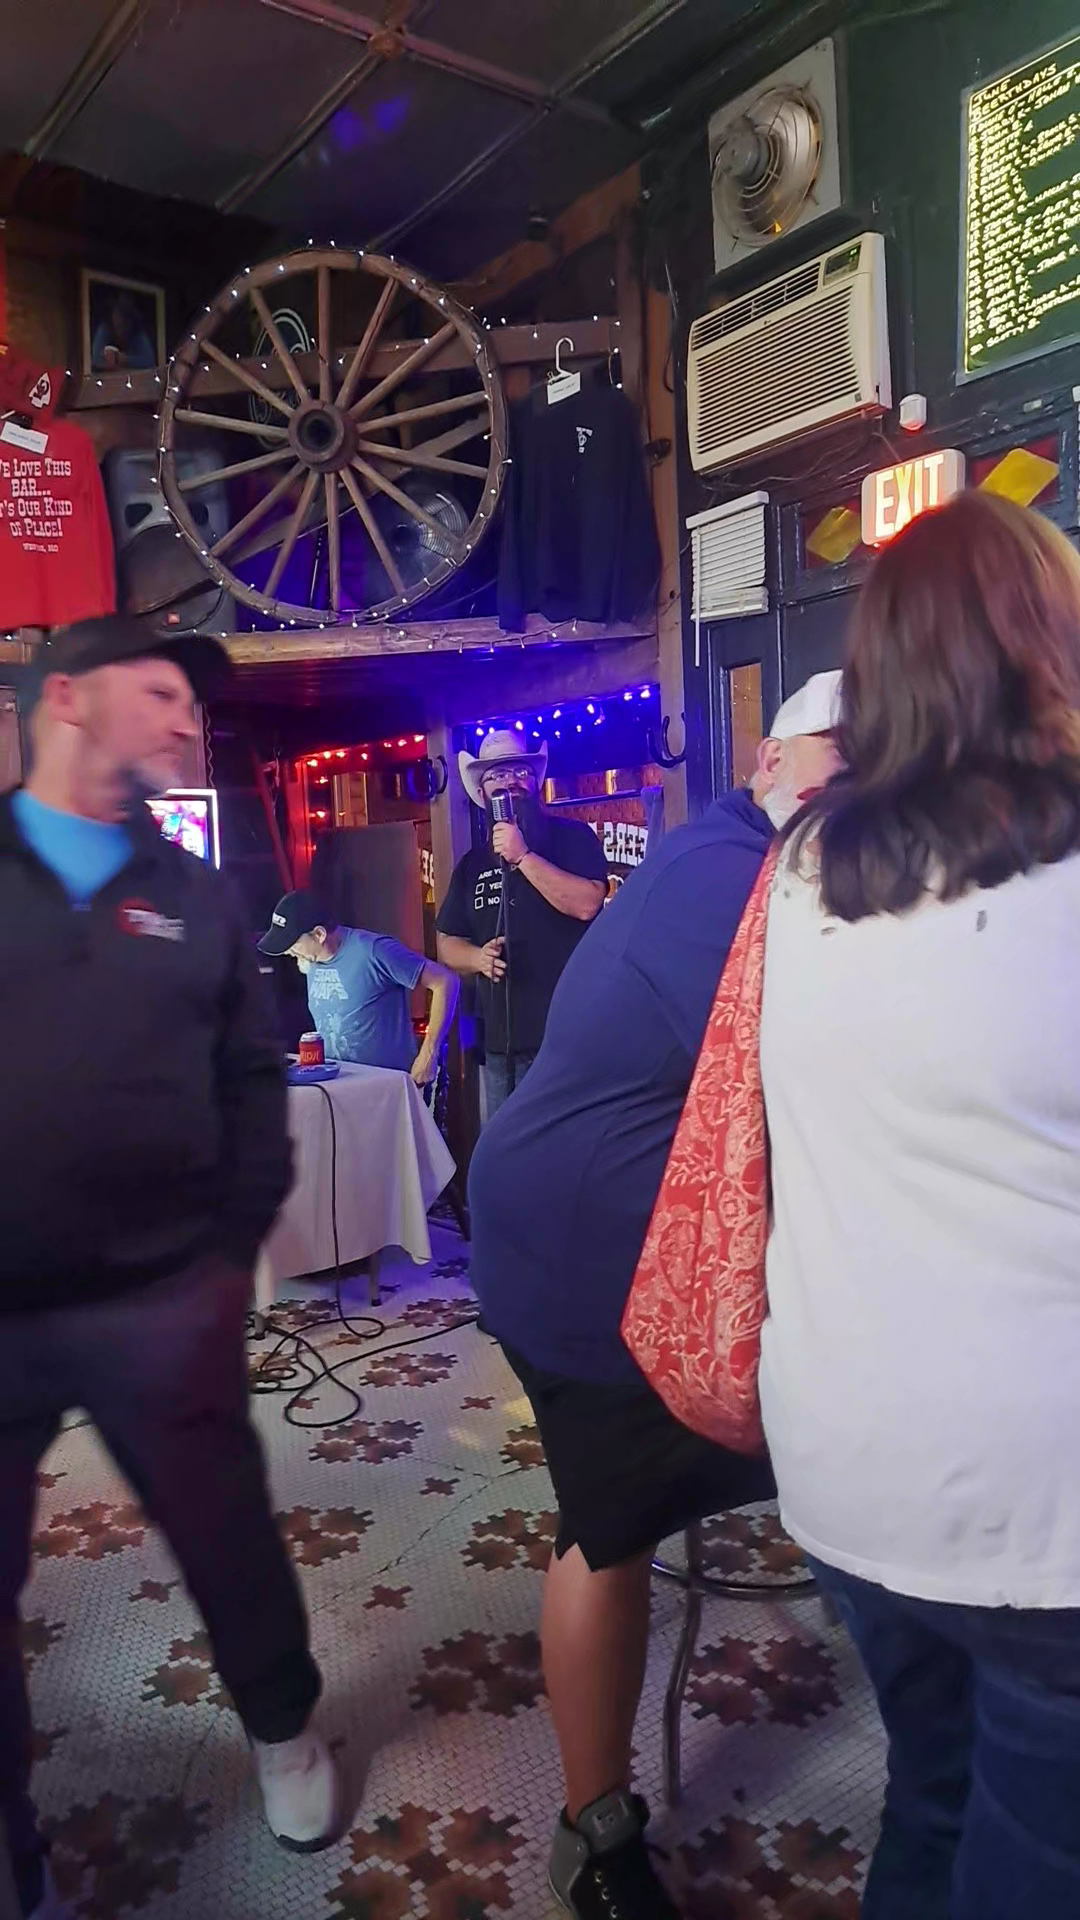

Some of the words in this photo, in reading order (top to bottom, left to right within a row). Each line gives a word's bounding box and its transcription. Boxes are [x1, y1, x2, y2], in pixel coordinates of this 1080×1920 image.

[971, 63, 1057, 122] BEERTHDAYS
[973, 79, 1011, 108] JUNE
[0, 459, 10, 477] E
[13, 458, 41, 477] LOVE
[45, 457, 71, 476] THIS
[876, 454, 944, 538] EXIT
[18, 498, 41, 517] OUR
[44, 497, 72, 516] KIND
[24, 517, 63, 537] PLACE!
[487, 896, 500, 905] NO
